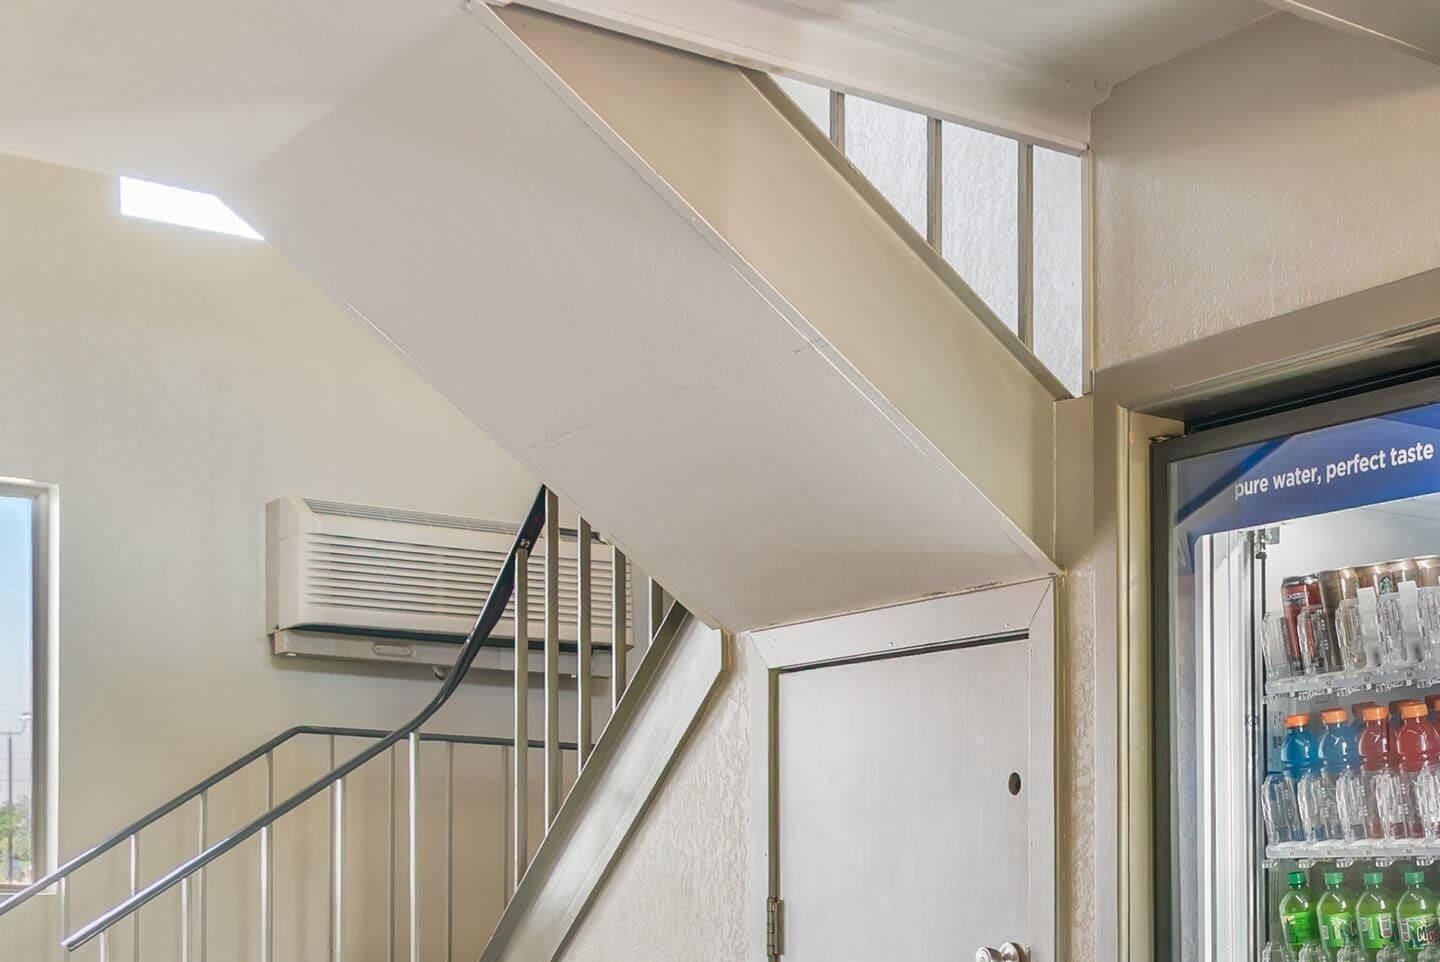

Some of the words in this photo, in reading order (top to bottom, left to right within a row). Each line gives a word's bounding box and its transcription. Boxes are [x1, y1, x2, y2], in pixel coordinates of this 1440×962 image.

[1234, 477, 1268, 500] pure
[1273, 467, 1322, 488] water,
[1326, 450, 1386, 482] perfect
[1390, 441, 1434, 464] taste
